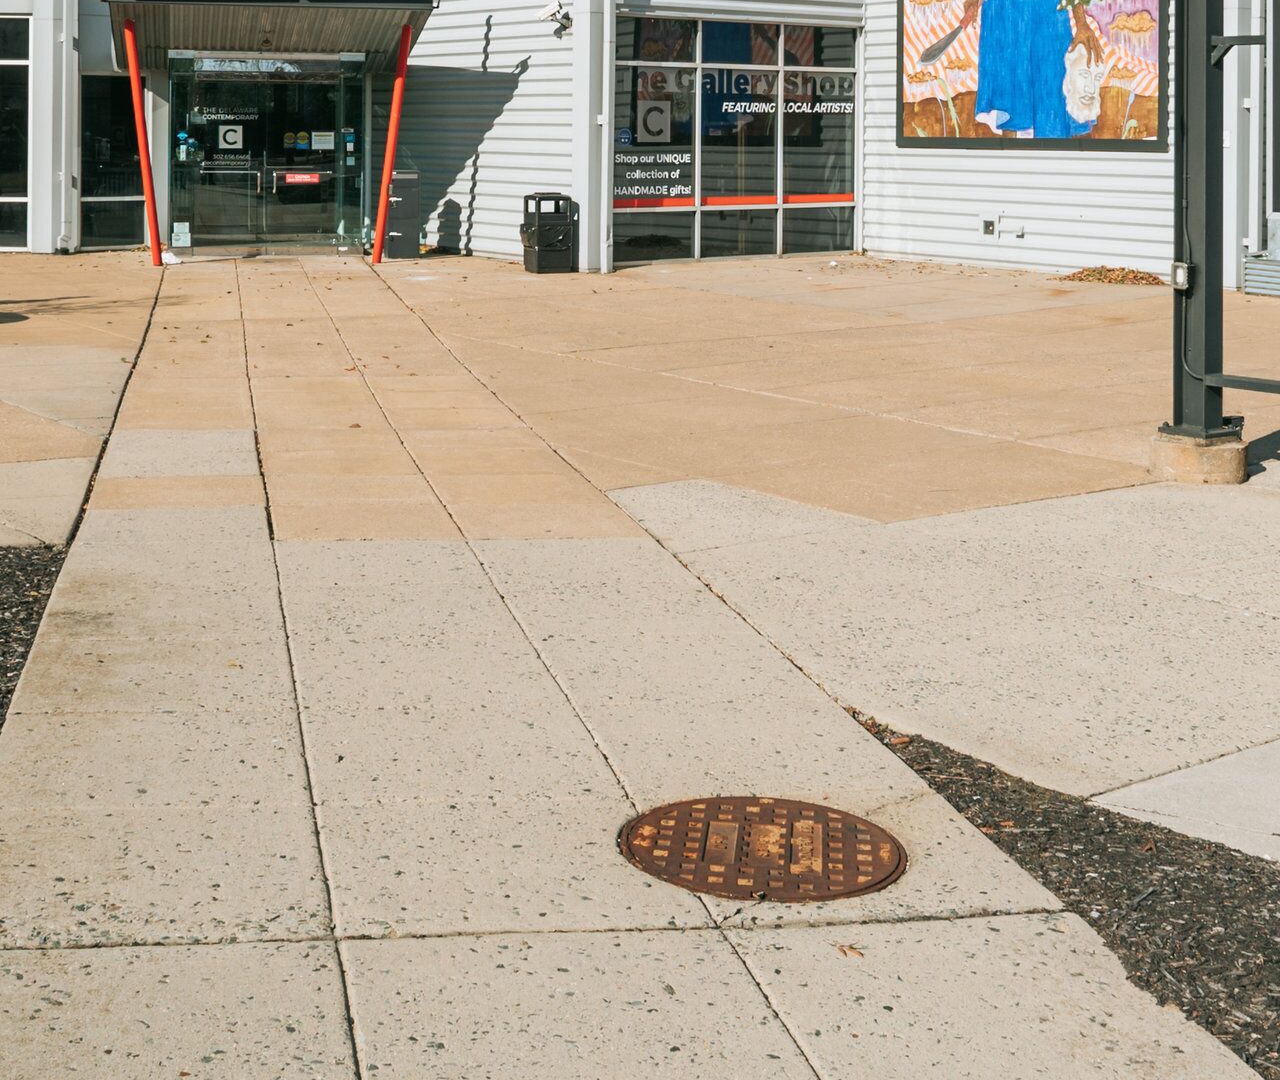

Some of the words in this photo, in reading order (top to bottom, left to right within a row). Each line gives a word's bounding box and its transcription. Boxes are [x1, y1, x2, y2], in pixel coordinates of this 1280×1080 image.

[783, 71, 854, 96] Shop
[722, 102, 776, 114] FEATURING
[783, 102, 812, 113] LOCAL
[813, 102, 854, 114] ARTISTS!
[642, 106, 665, 137] C
[222, 128, 238, 146] C
[615, 153, 638, 165] Shop
[640, 155, 655, 163] our
[656, 153, 691, 165] UNIQUE
[625, 169, 669, 179] collection
[670, 169, 681, 179] of
[614, 185, 668, 195] HANDMADE
[669, 184, 692, 196] gifts!
